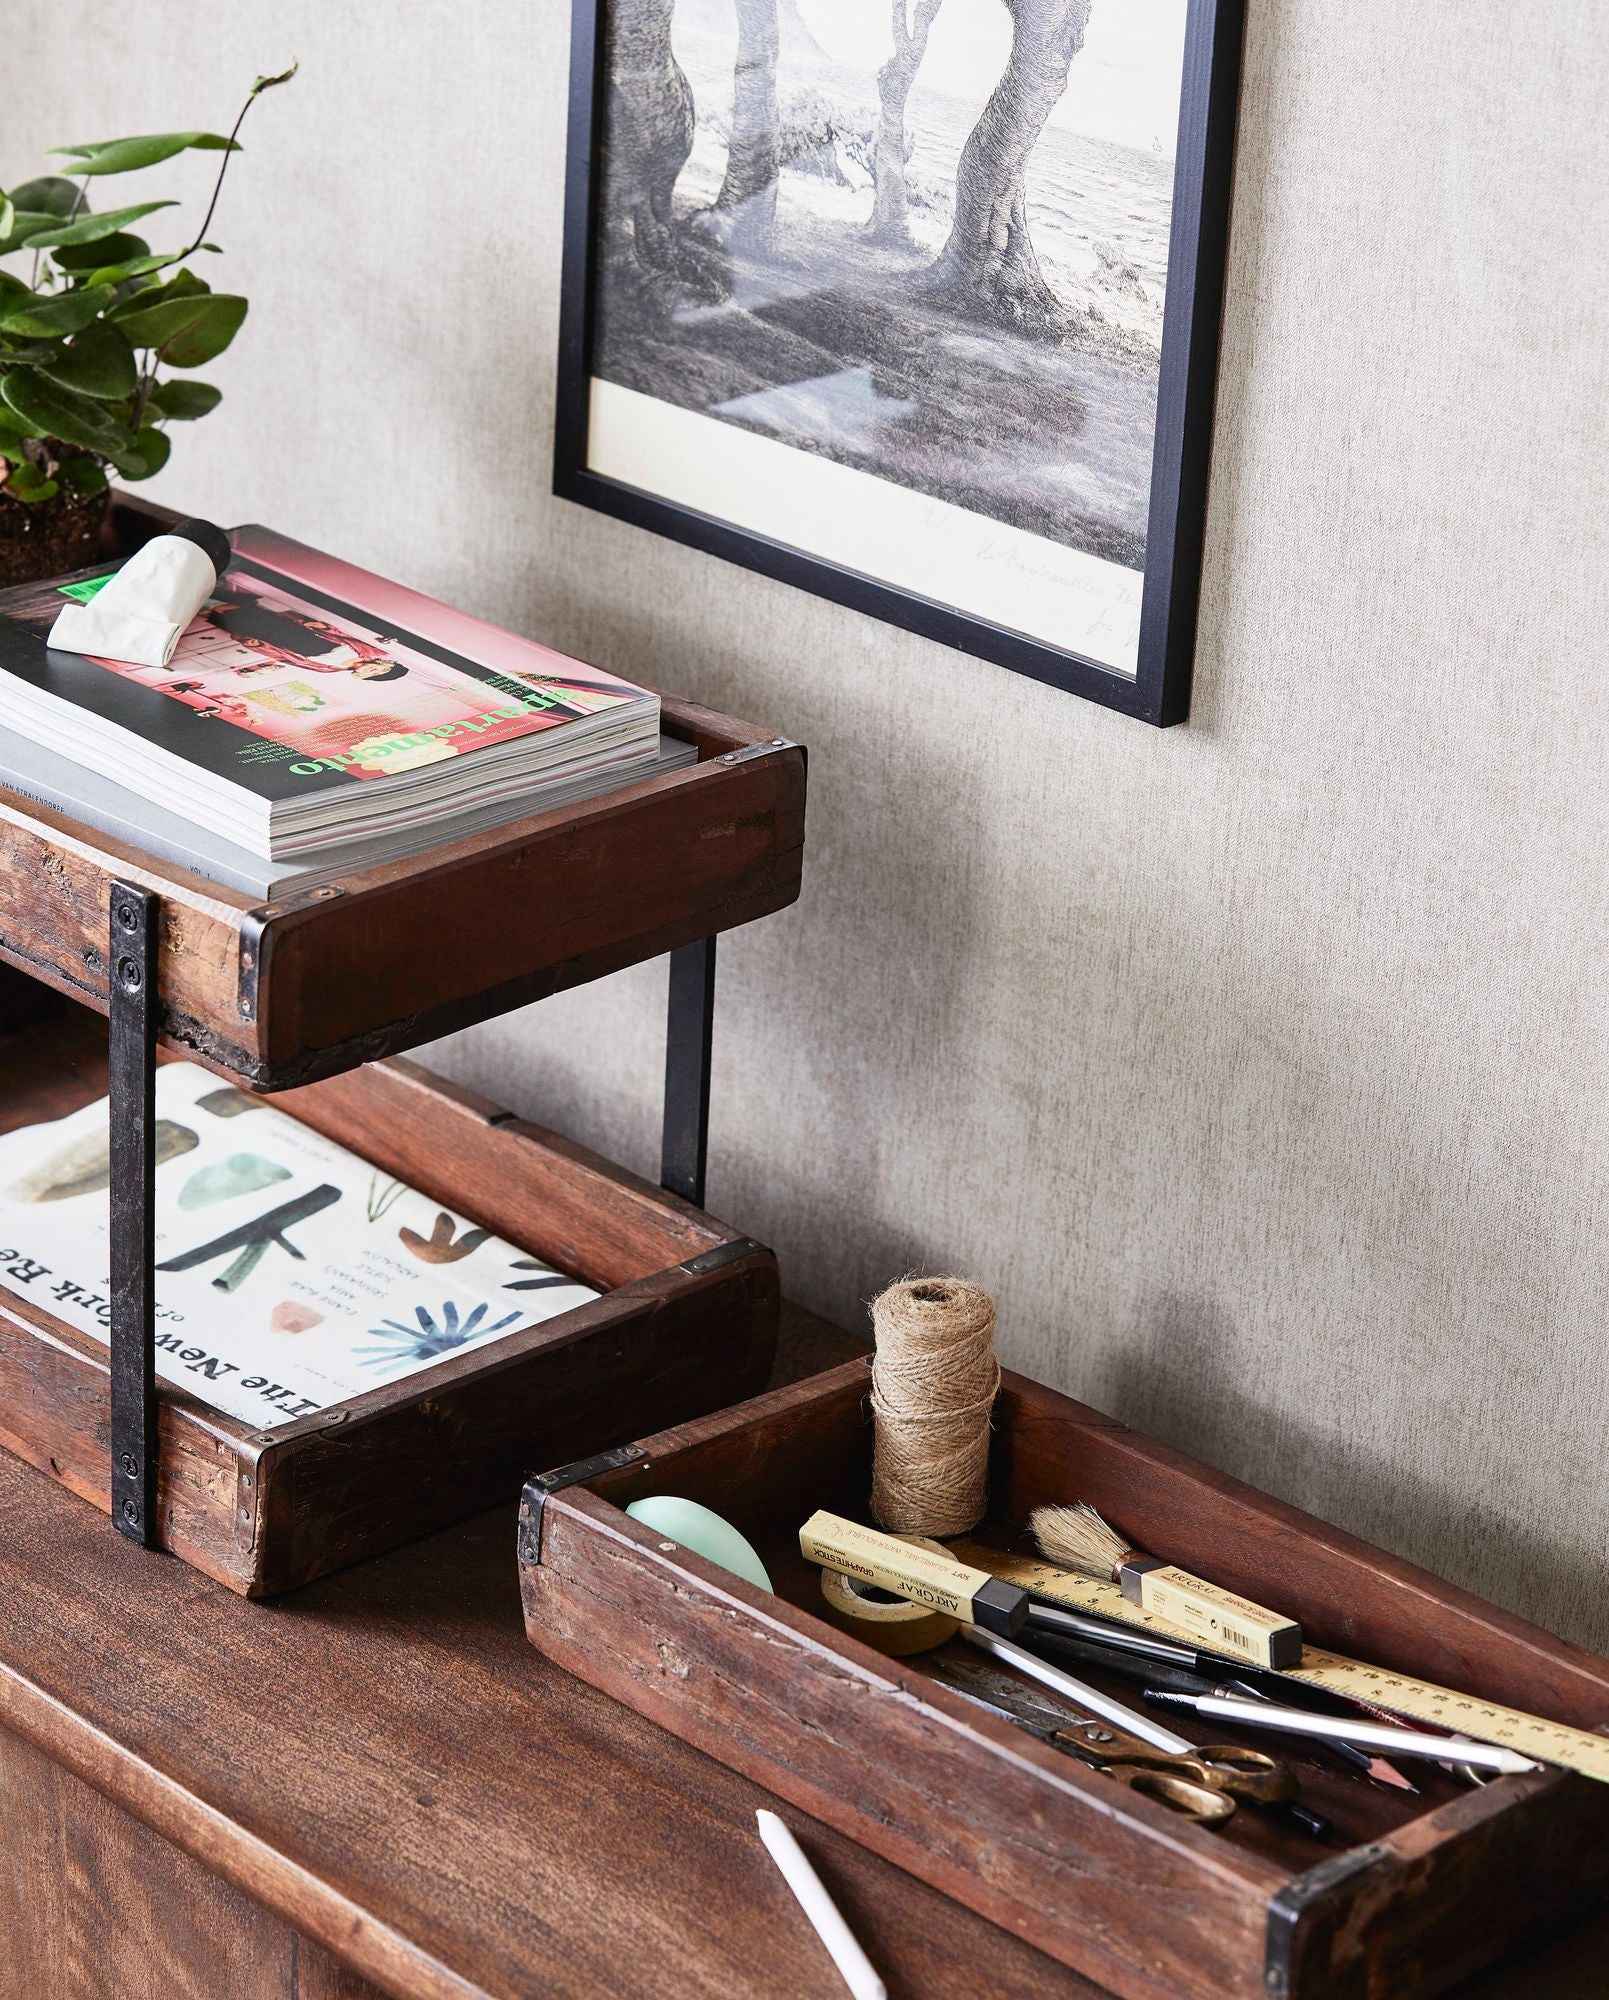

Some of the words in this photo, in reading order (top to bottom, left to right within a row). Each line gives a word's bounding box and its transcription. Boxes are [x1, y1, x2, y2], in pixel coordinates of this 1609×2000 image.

[50, 1280, 112, 1327] ork
[154, 1333, 240, 1380] New
[240, 1376, 322, 1418] The
